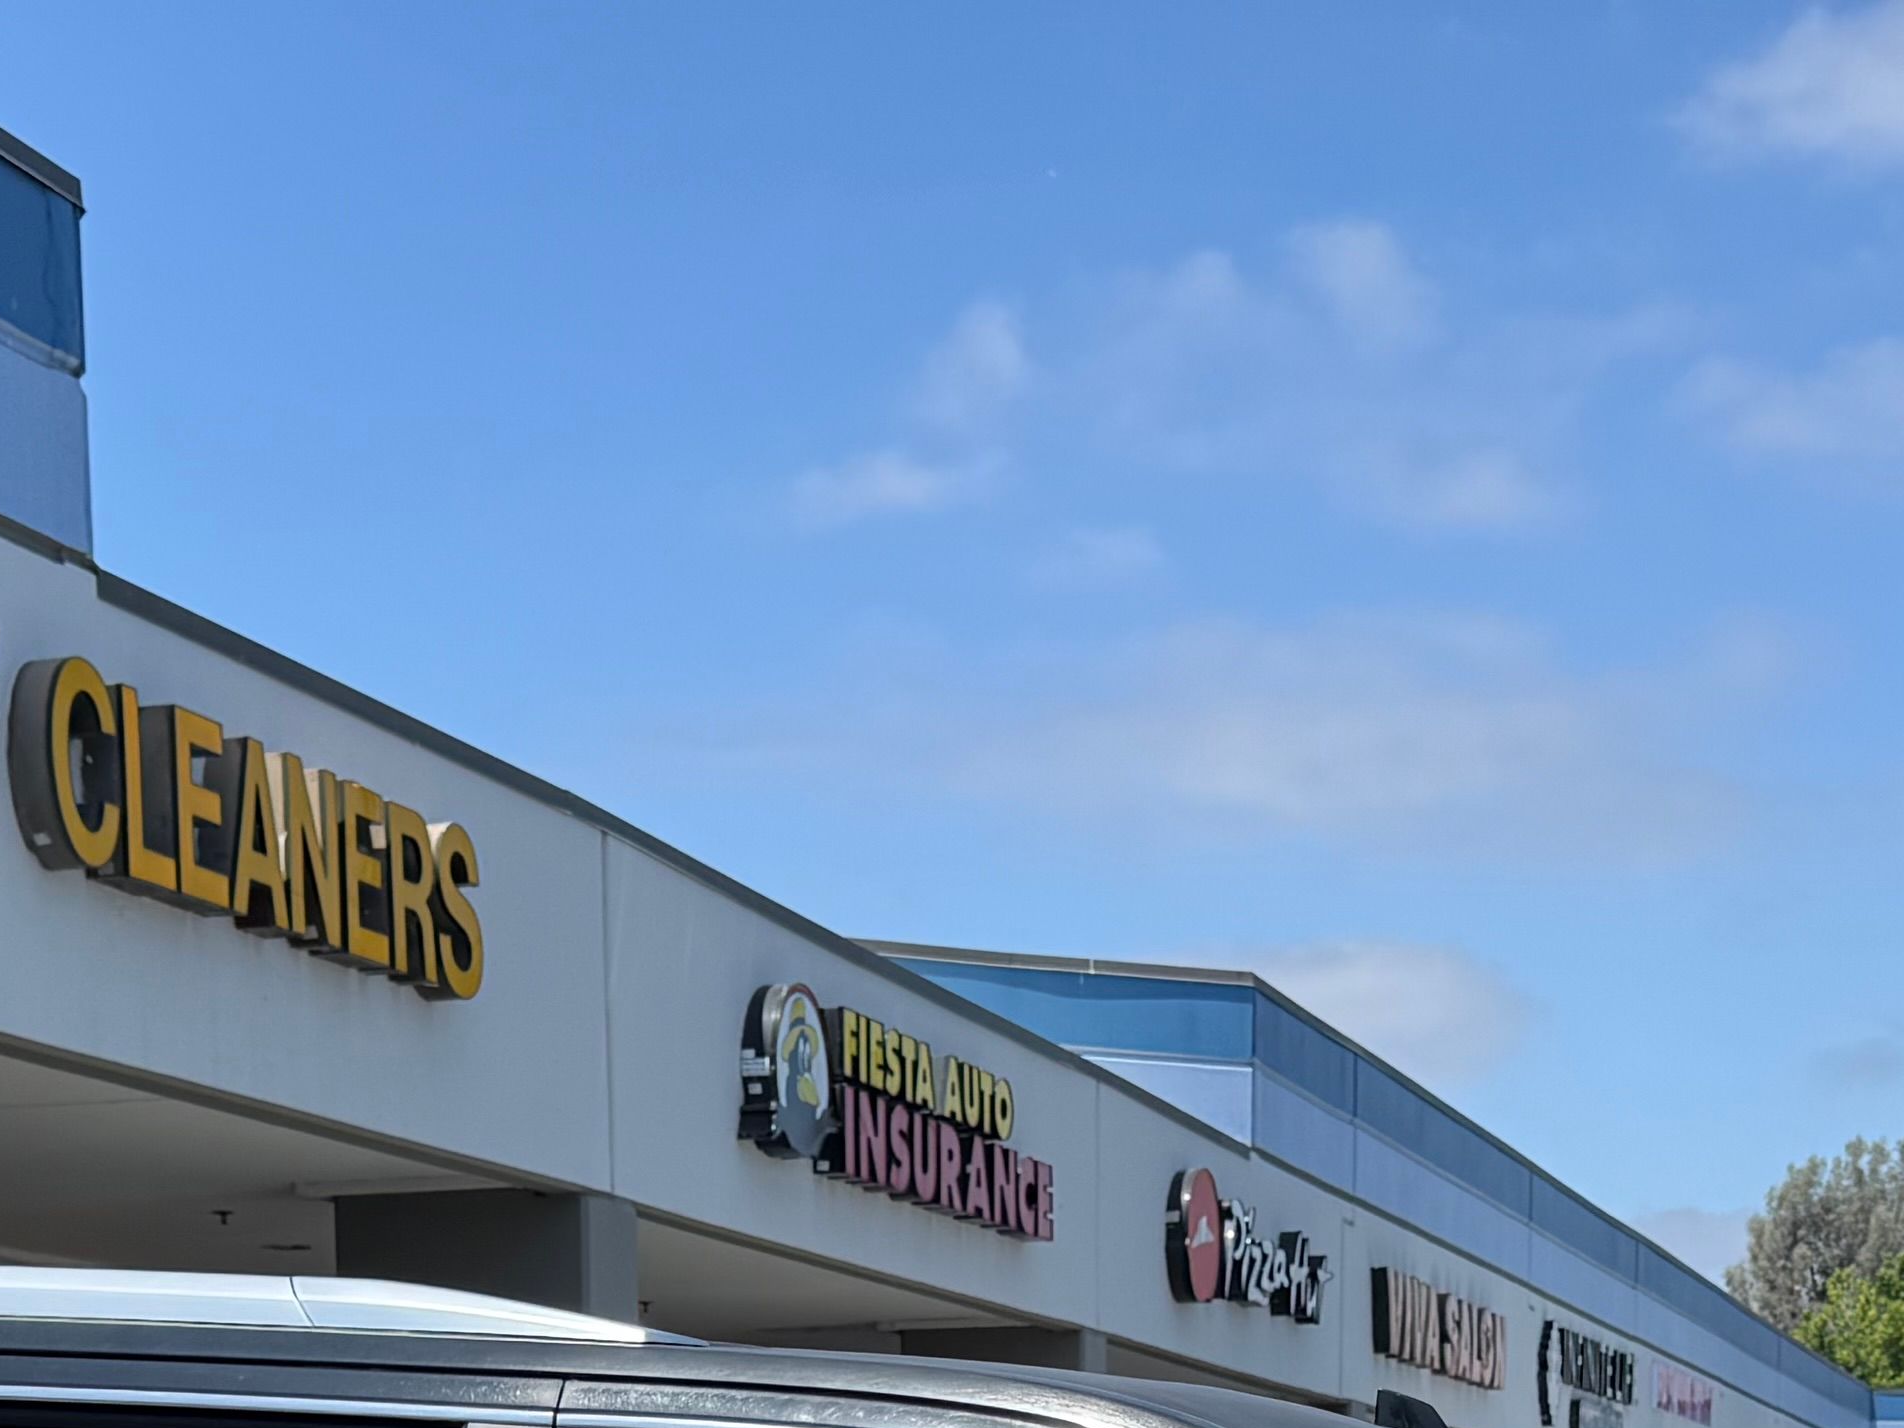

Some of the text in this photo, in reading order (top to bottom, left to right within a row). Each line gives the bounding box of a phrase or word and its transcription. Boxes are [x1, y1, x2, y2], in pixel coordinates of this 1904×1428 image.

[49, 655, 485, 1002] CLEANERS
[841, 1007, 1015, 1141] FIESTA AUTO
[843, 1085, 1054, 1242] INSURANCE
[1224, 1199, 1334, 1319] Pizza Hut
[1387, 1268, 1441, 1372] VIVA
[1443, 1294, 1506, 1391] SALON
